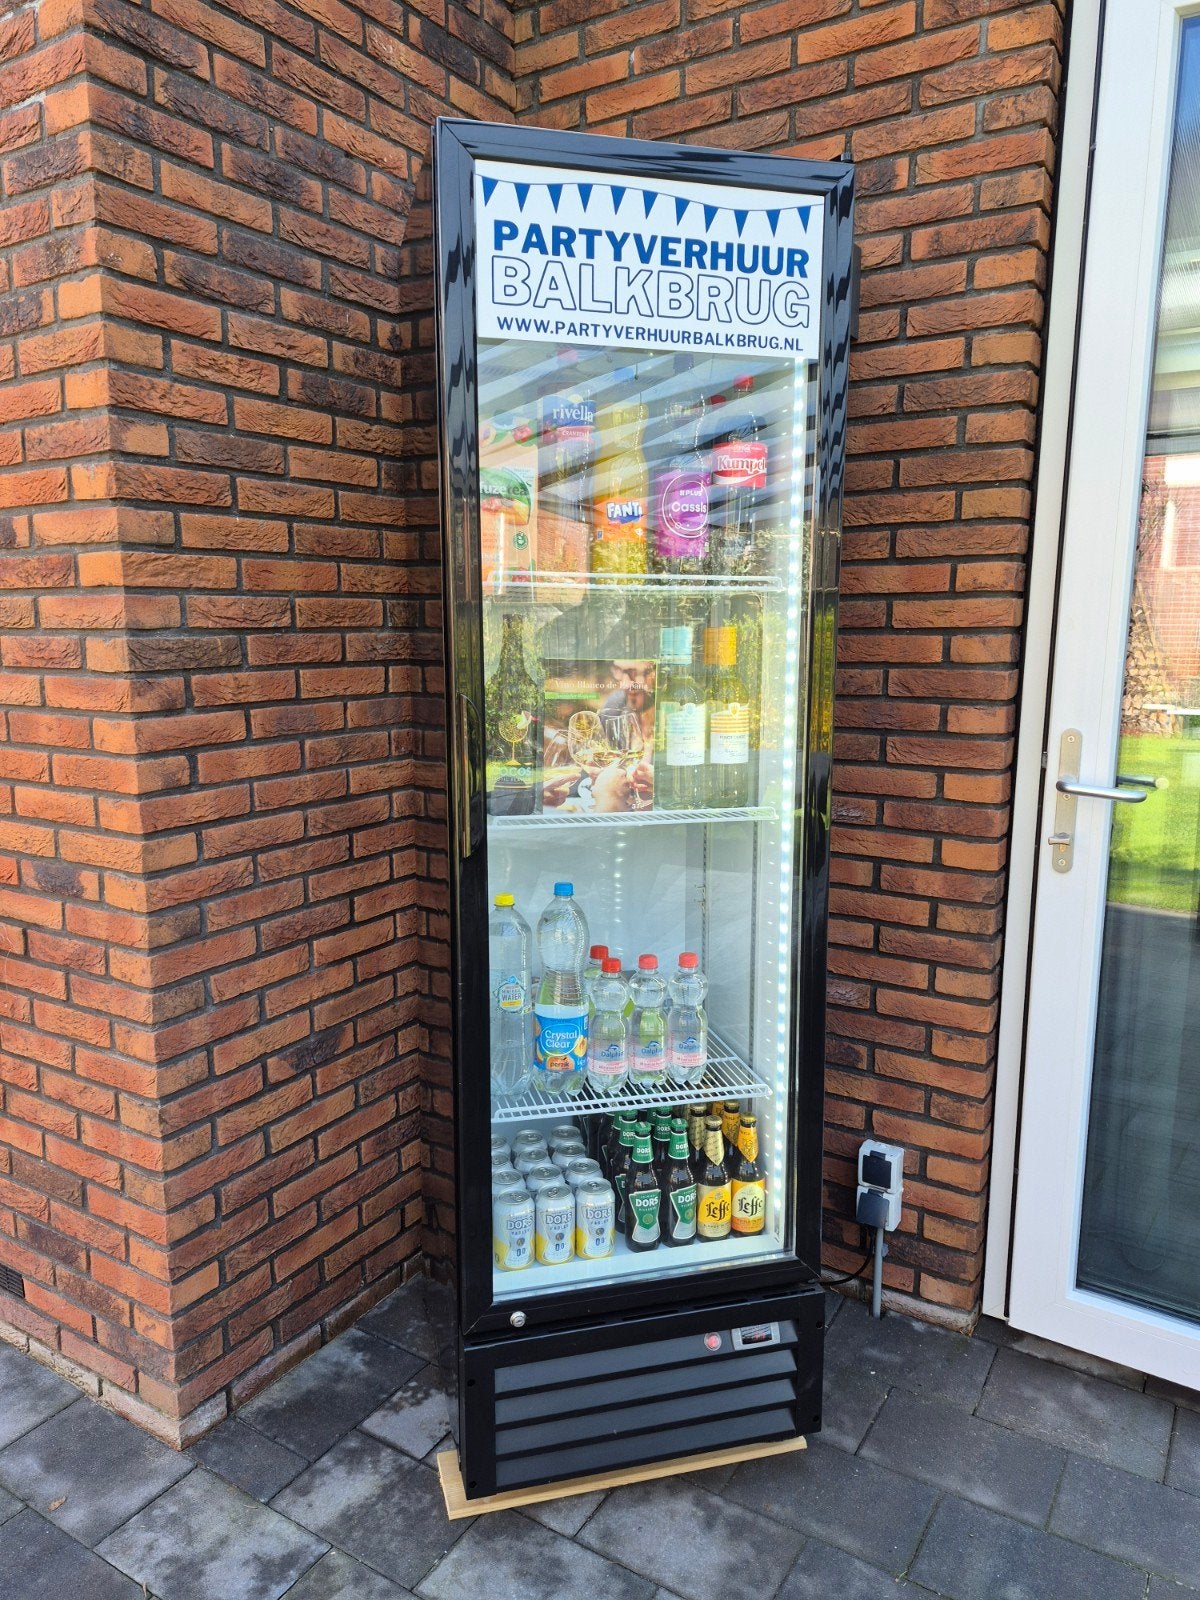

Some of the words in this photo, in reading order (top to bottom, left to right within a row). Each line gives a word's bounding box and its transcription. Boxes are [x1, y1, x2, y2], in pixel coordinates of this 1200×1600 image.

[493, 219, 810, 279] PARTYVERHUUR
[491, 255, 810, 329] BALKBRUG
[496, 316, 804, 352] WWW.PARTYVERHUURBALKBRUG.NL
[552, 404, 594, 423] rivella
[671, 501, 707, 513] Cassis
[577, 680, 605, 689] Blanco
[544, 1029, 578, 1040] Crystal
[545, 1039, 571, 1049] Clear
[635, 1197, 659, 1207] DORS
[738, 1196, 763, 1217] Leffe
[545, 1212, 573, 1225] DORS
[586, 1208, 612, 1220] DORS
